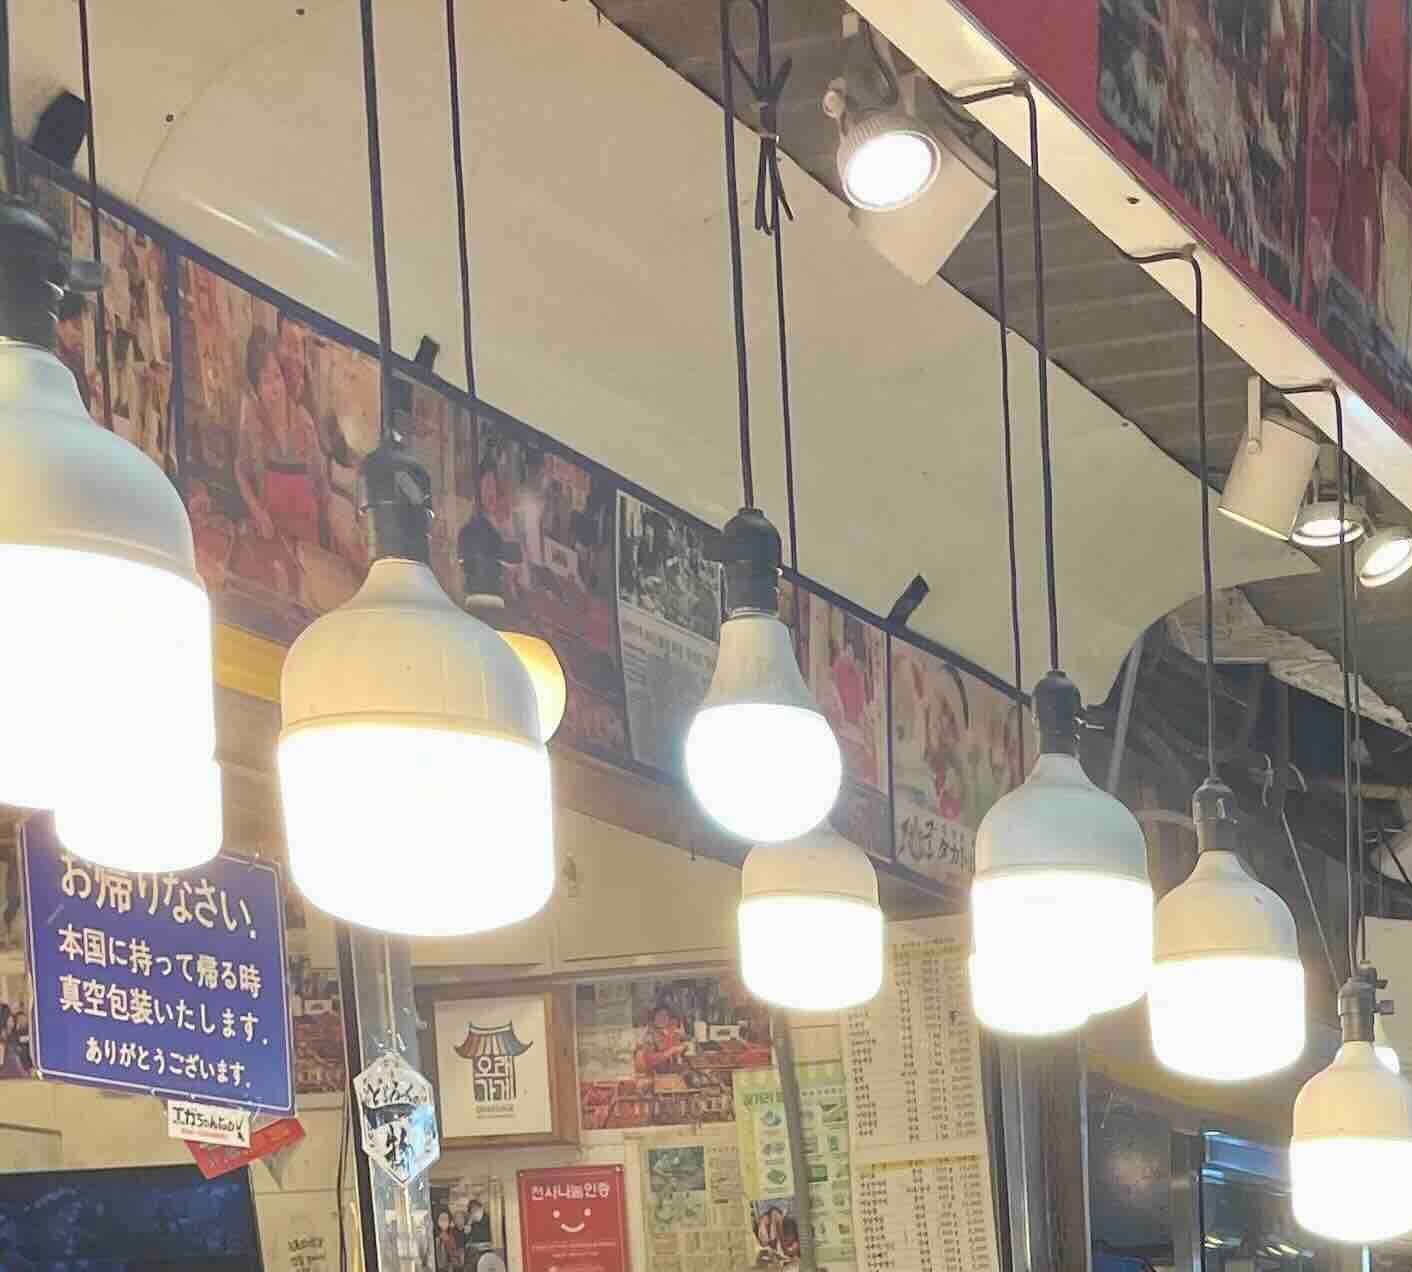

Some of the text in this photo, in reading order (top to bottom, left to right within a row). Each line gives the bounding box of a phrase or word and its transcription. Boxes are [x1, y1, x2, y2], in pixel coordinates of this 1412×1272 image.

[58, 923, 263, 998] 本国に持って帰る時
[475, 1079, 513, 1104] 가게
